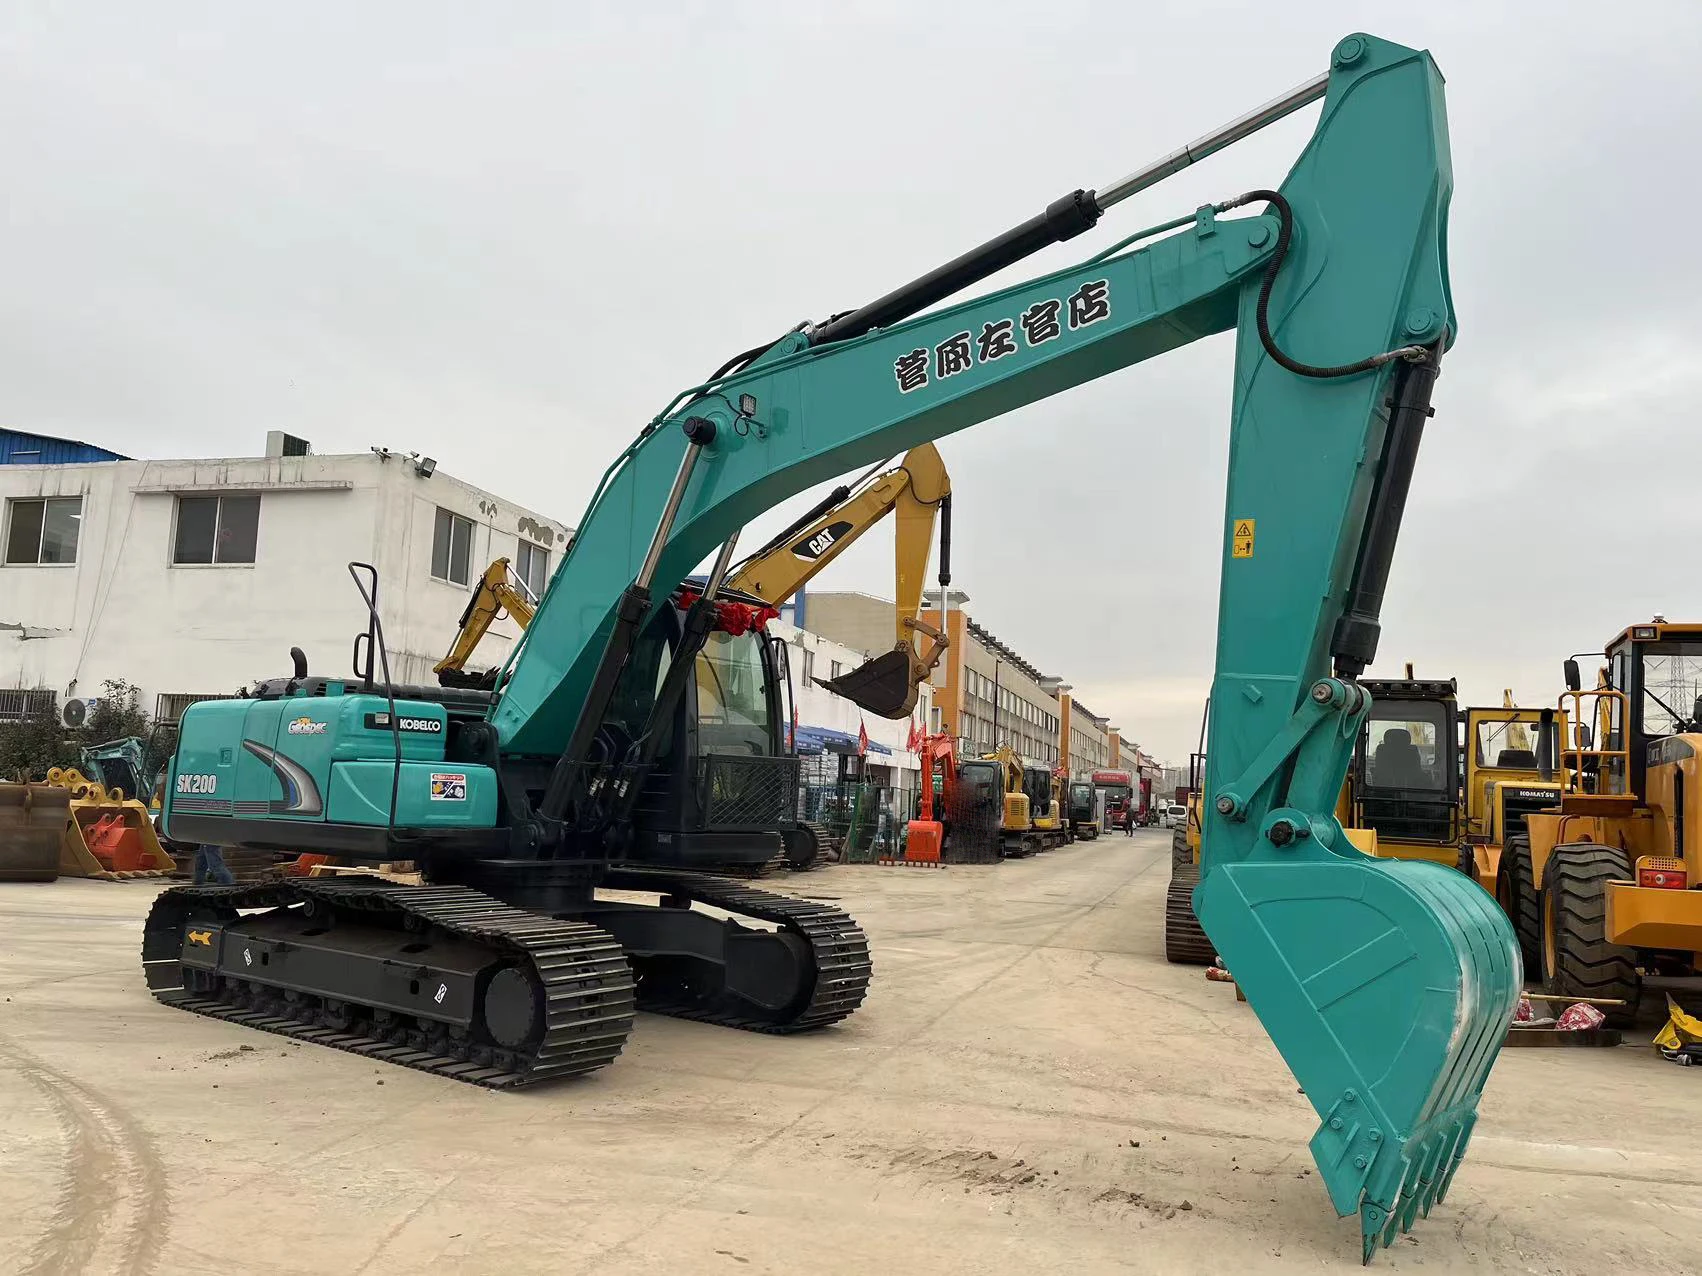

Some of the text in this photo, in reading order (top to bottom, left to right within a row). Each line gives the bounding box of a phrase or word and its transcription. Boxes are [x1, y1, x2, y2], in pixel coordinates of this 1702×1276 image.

[808, 528, 836, 555] CAT
[399, 718, 441, 732] KOBELCO
[176, 773, 217, 794] SK200
[1519, 790, 1555, 798] KOMATSU
